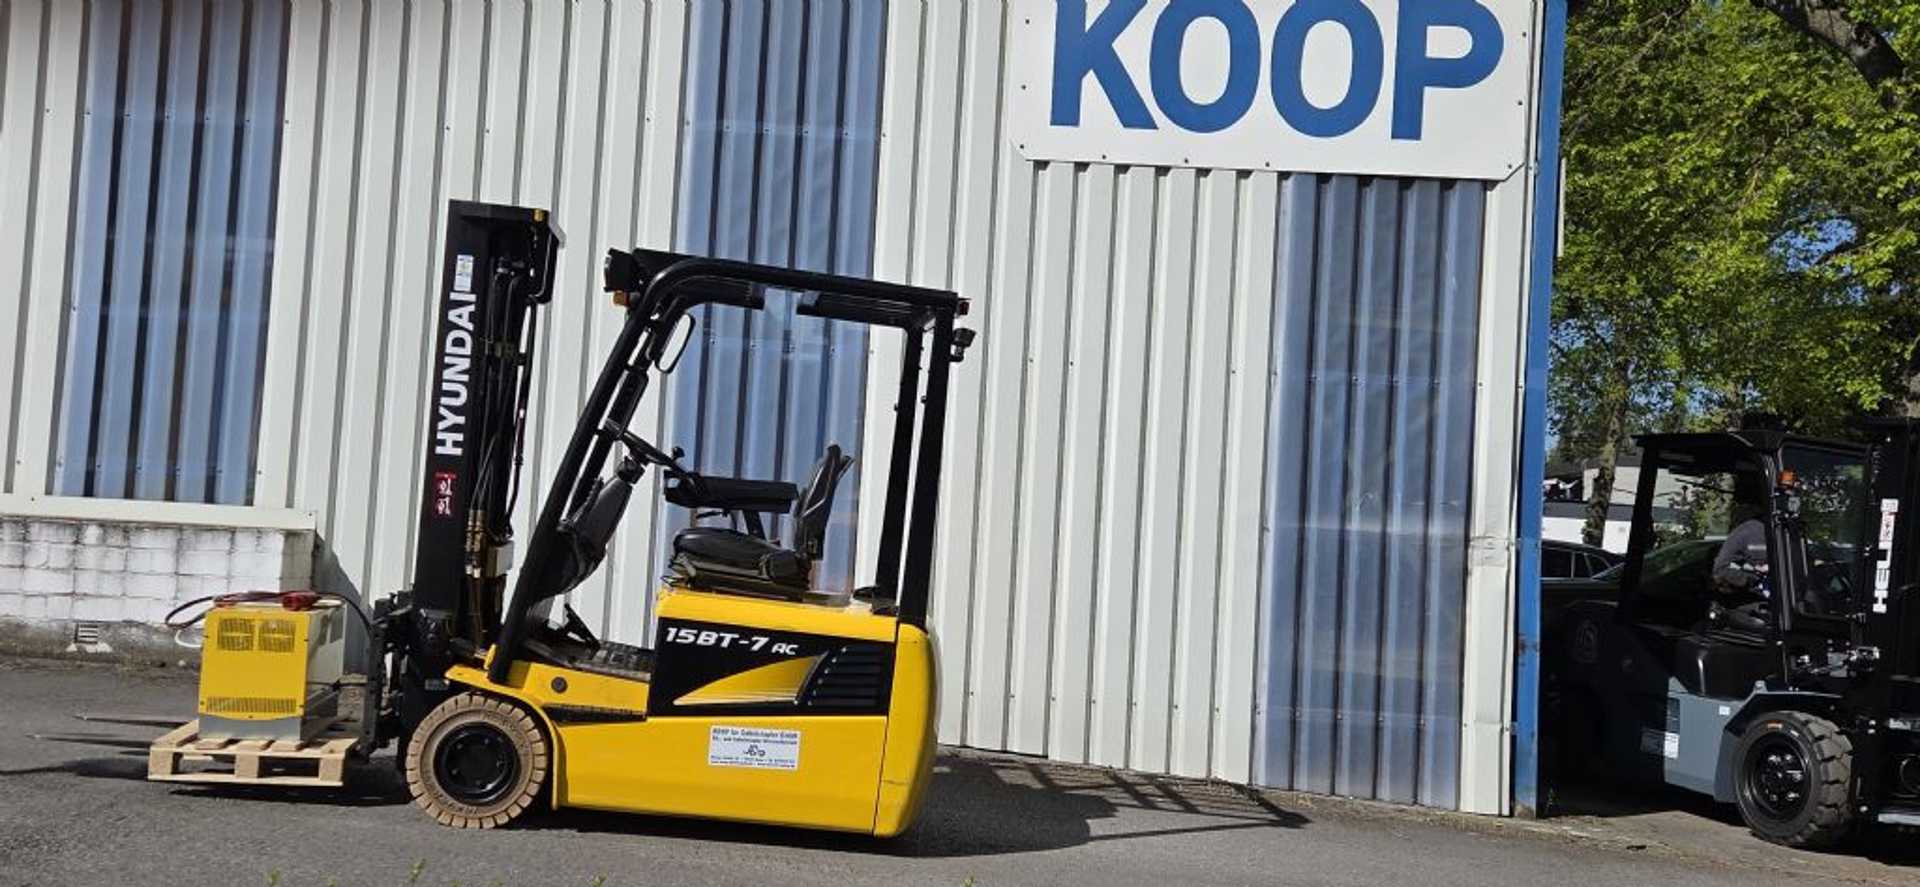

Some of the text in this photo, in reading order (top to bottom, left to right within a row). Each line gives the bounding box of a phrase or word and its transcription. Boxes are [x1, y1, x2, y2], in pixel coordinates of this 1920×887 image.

[1050, 0, 1504, 141] KOOP
[435, 292, 477, 455] HYUNDAI
[1872, 541, 1893, 613] HELI
[666, 627, 798, 655] 15BT-7 AC
